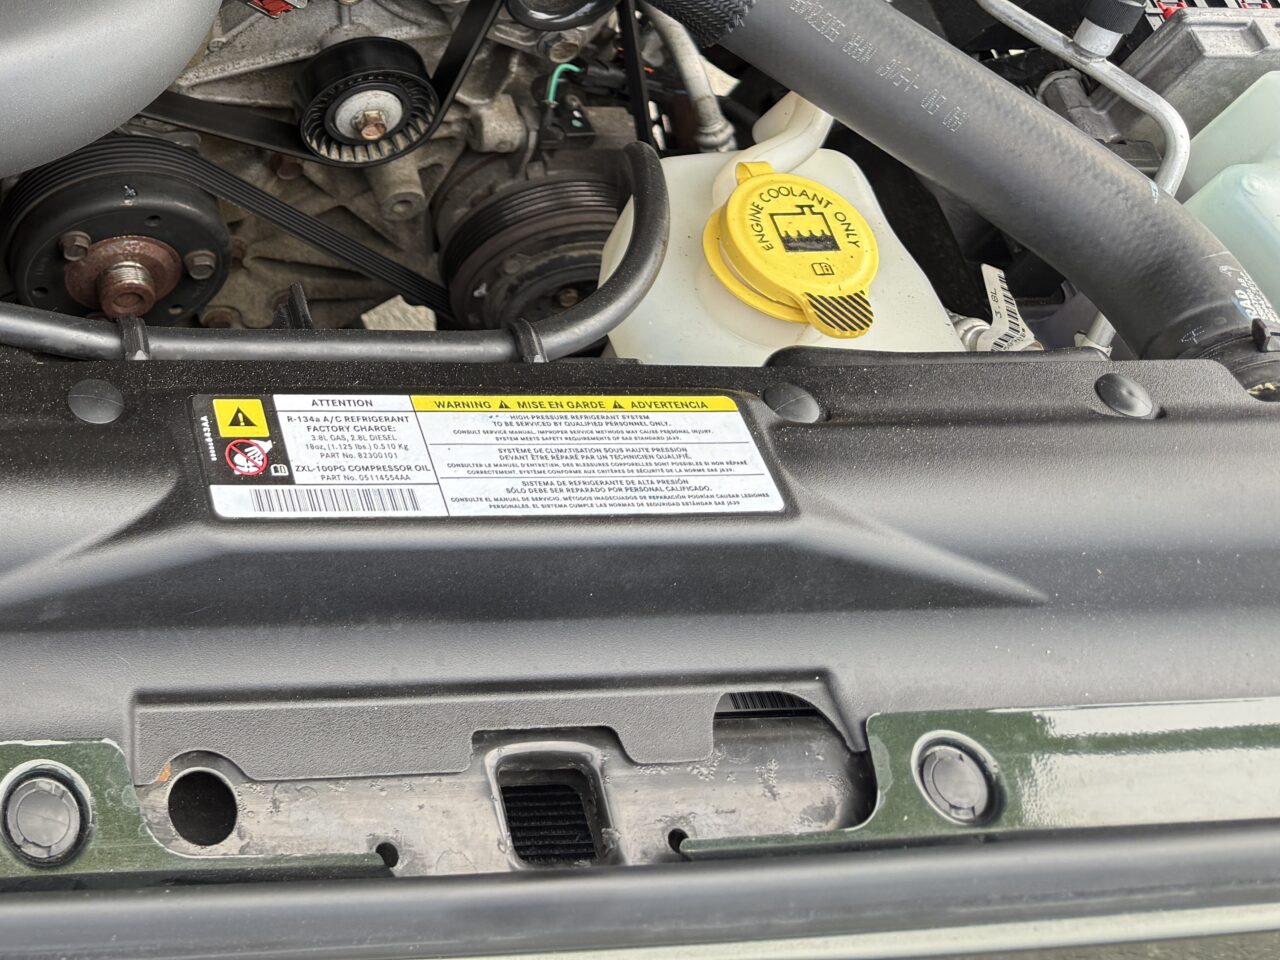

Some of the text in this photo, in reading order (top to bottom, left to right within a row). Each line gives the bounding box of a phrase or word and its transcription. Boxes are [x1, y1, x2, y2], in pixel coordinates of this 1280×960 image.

[748, 186, 861, 251] ENGINE COOLANT ONLY
[990, 288, 1003, 318] 3.8L
[310, 399, 373, 408] ATTENTION
[434, 400, 709, 409] WARNING MISE EN GARDE ADVERTENCIA
[286, 415, 409, 423] R-134a A/C REFRIGERANT
[306, 424, 396, 433] FACTORY CHARGE:
[295, 464, 431, 473] ZXL-100PG COMPRESSOR OIL
